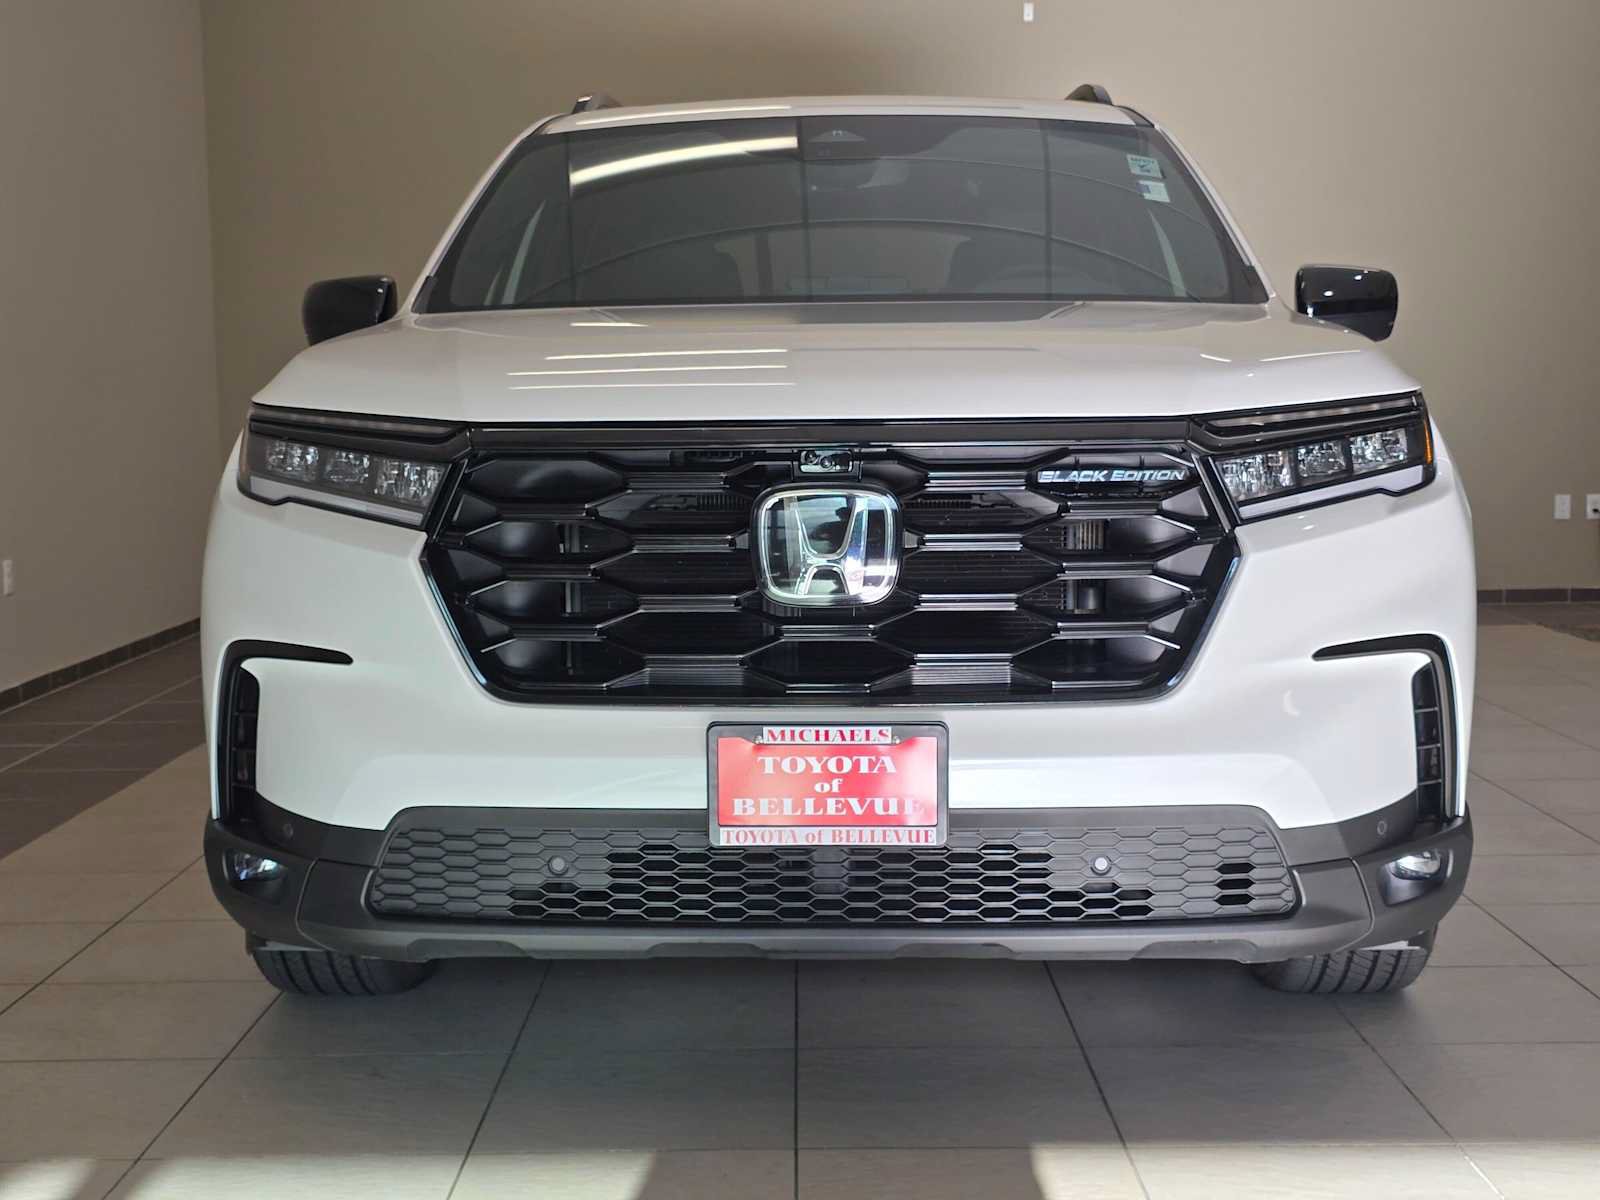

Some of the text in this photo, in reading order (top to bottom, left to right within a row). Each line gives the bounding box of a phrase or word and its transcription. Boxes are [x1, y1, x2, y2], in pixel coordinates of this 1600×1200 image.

[1038, 469, 1185, 483] BLACK EDITION
[767, 728, 891, 742] MICHAELS
[757, 756, 897, 774] TOYOTA
[814, 778, 843, 793] of
[732, 797, 925, 816] BELLEVUE
[723, 829, 935, 844] TOYOTA of BELLEVUE
